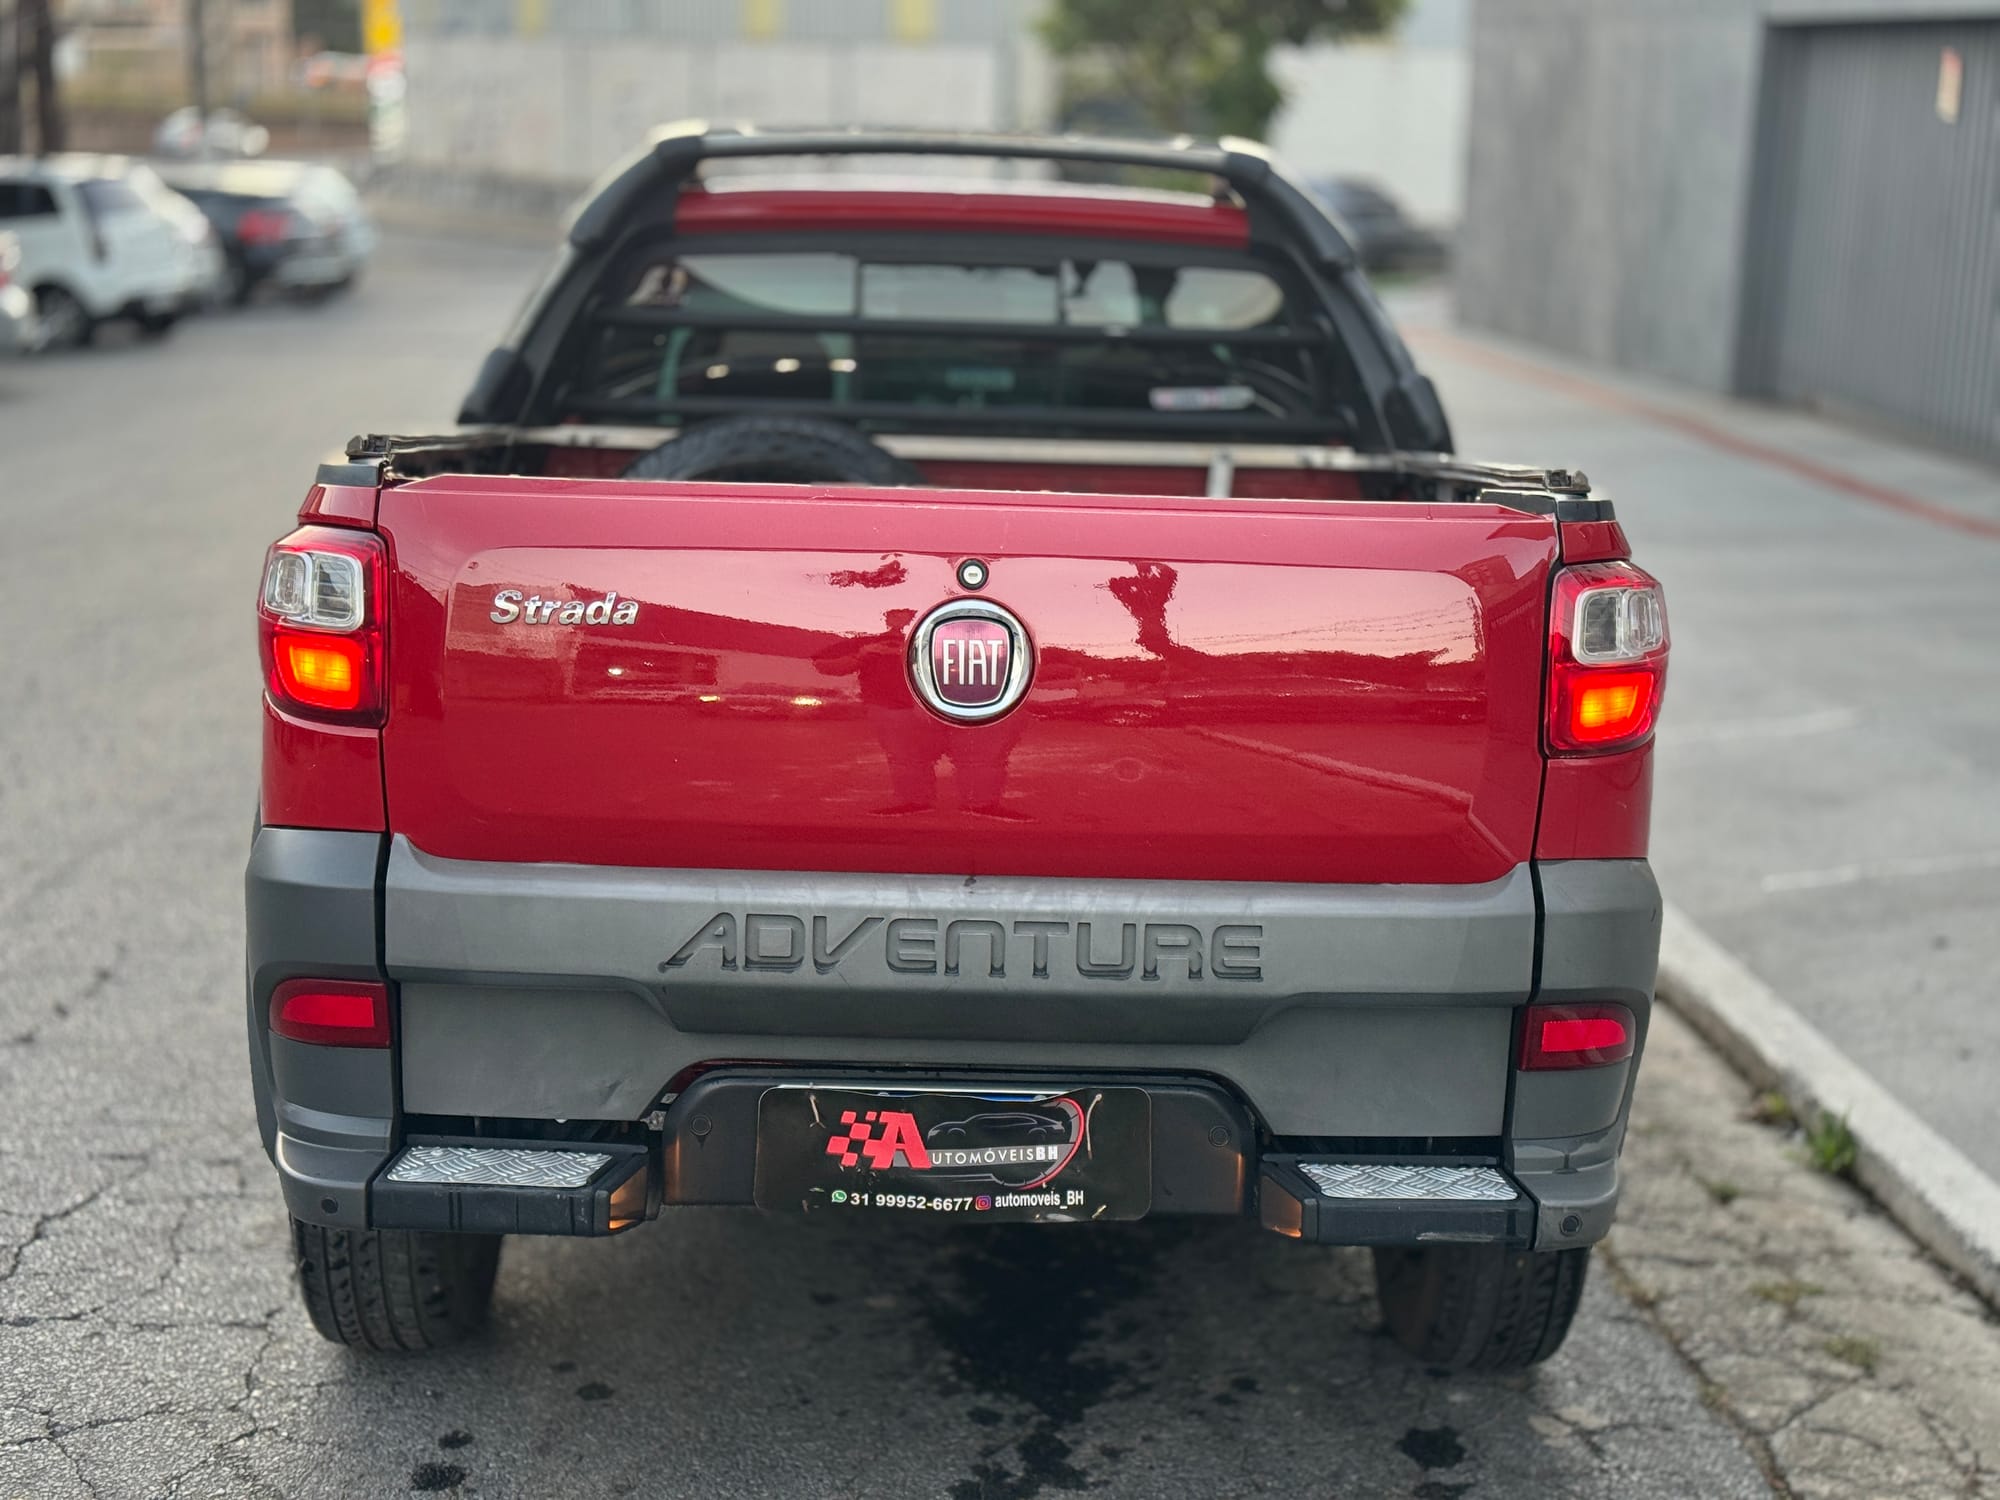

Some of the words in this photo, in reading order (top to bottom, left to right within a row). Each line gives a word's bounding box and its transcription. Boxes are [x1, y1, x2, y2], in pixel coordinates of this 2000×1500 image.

[489, 589, 639, 626] Strada
[942, 639, 1004, 686] FIAT
[658, 912, 1264, 982] ADVENTURE
[850, 1193, 869, 1207] 31
[875, 1194, 973, 1211] 99952-6677
[994, 1190, 1083, 1208] automoveis_BH
